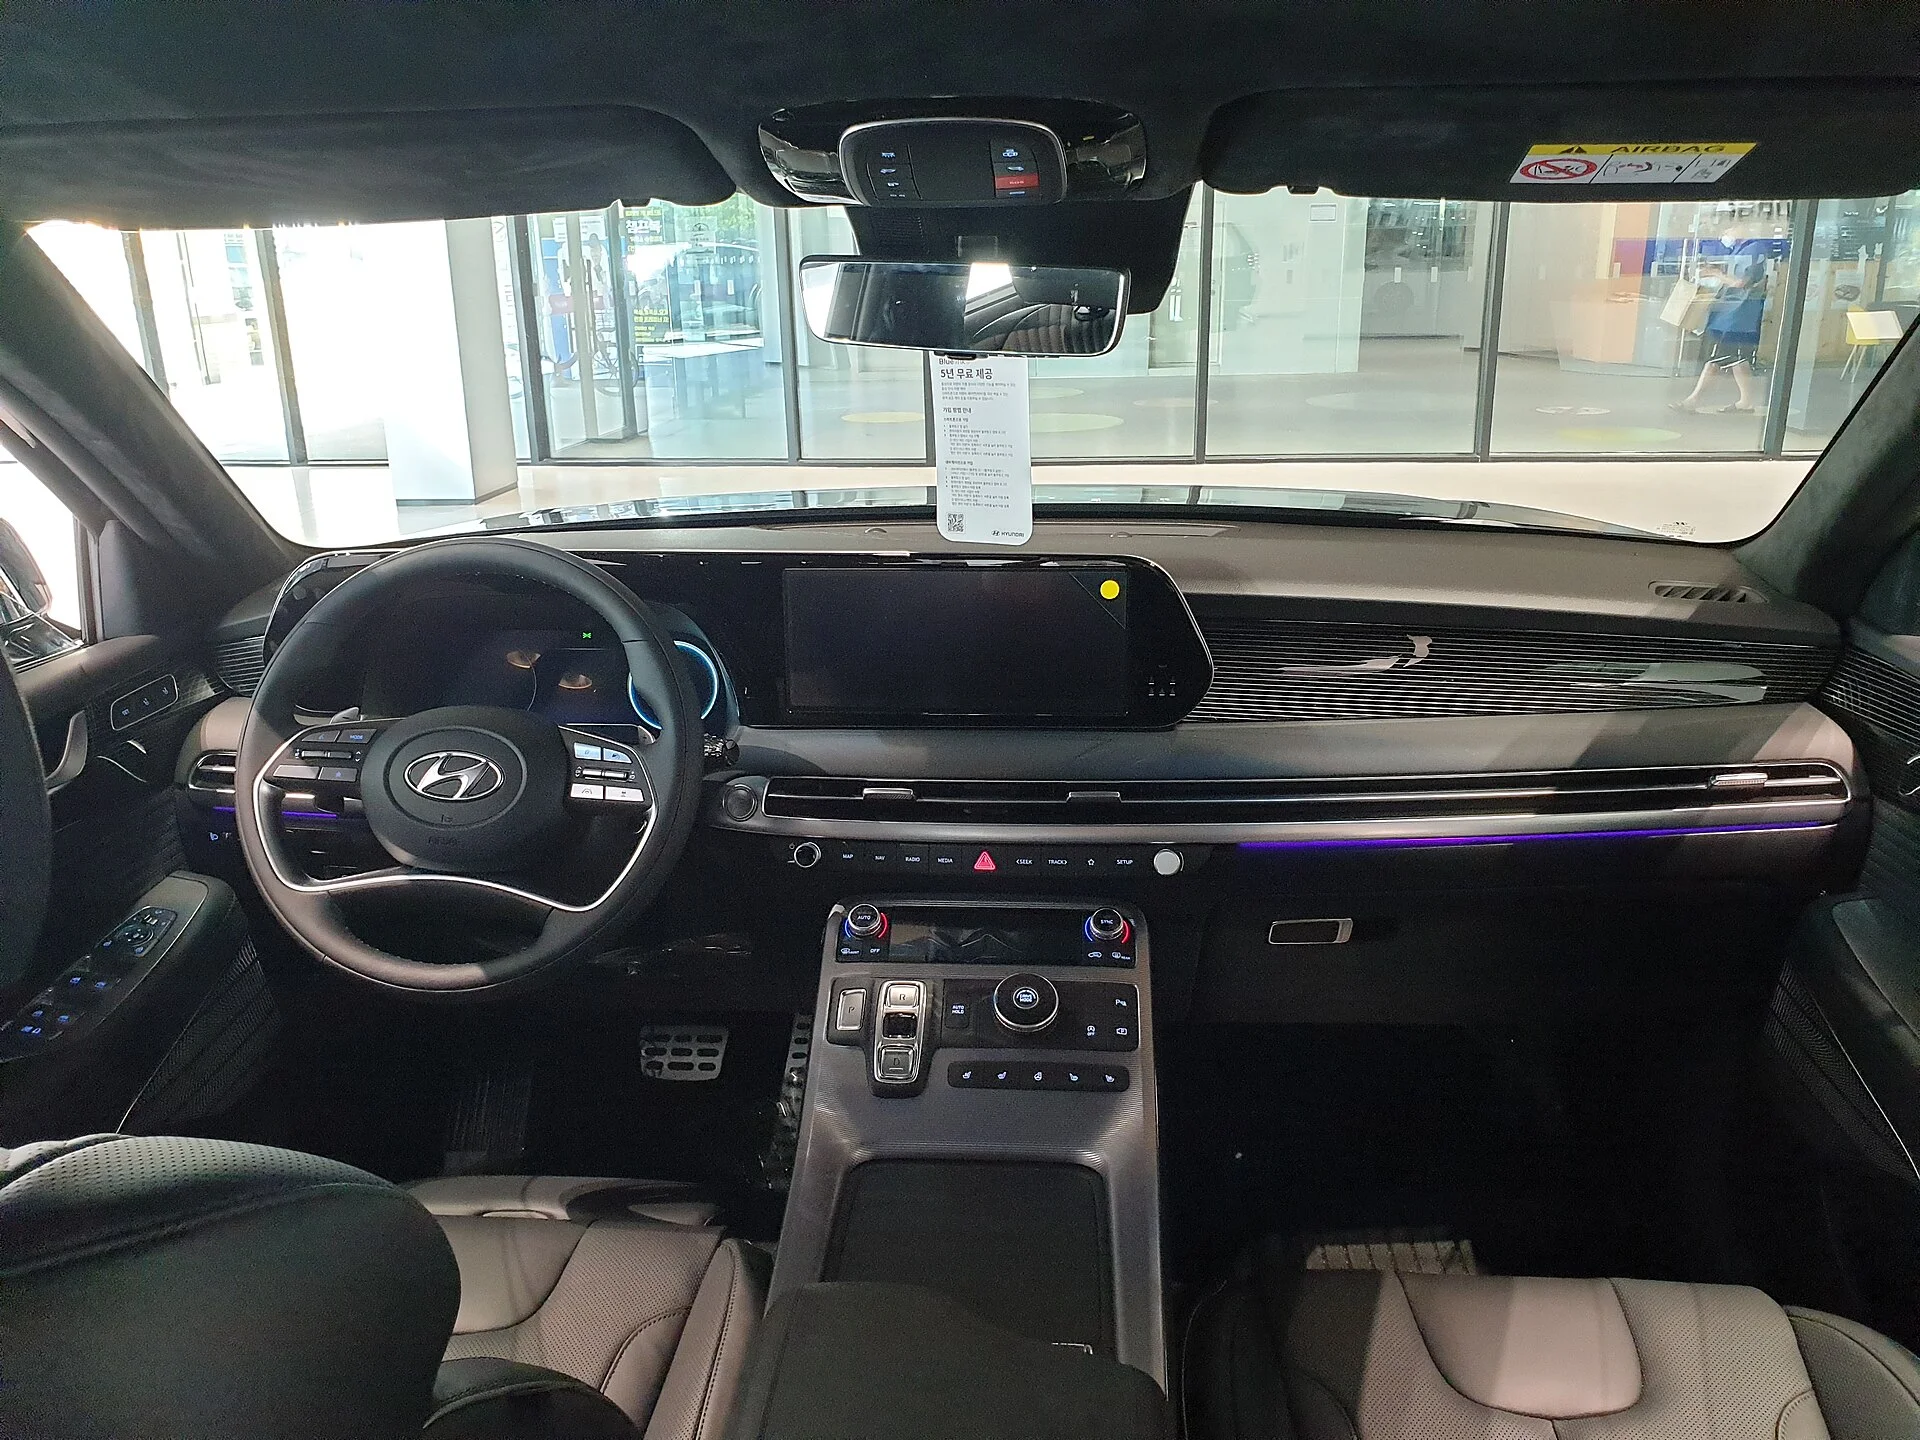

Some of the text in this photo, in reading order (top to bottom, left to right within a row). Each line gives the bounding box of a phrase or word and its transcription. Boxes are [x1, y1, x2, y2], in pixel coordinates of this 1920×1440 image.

[1610, 145, 1726, 153] AIRBAG
[940, 368, 993, 380] 5년 무료 제공
